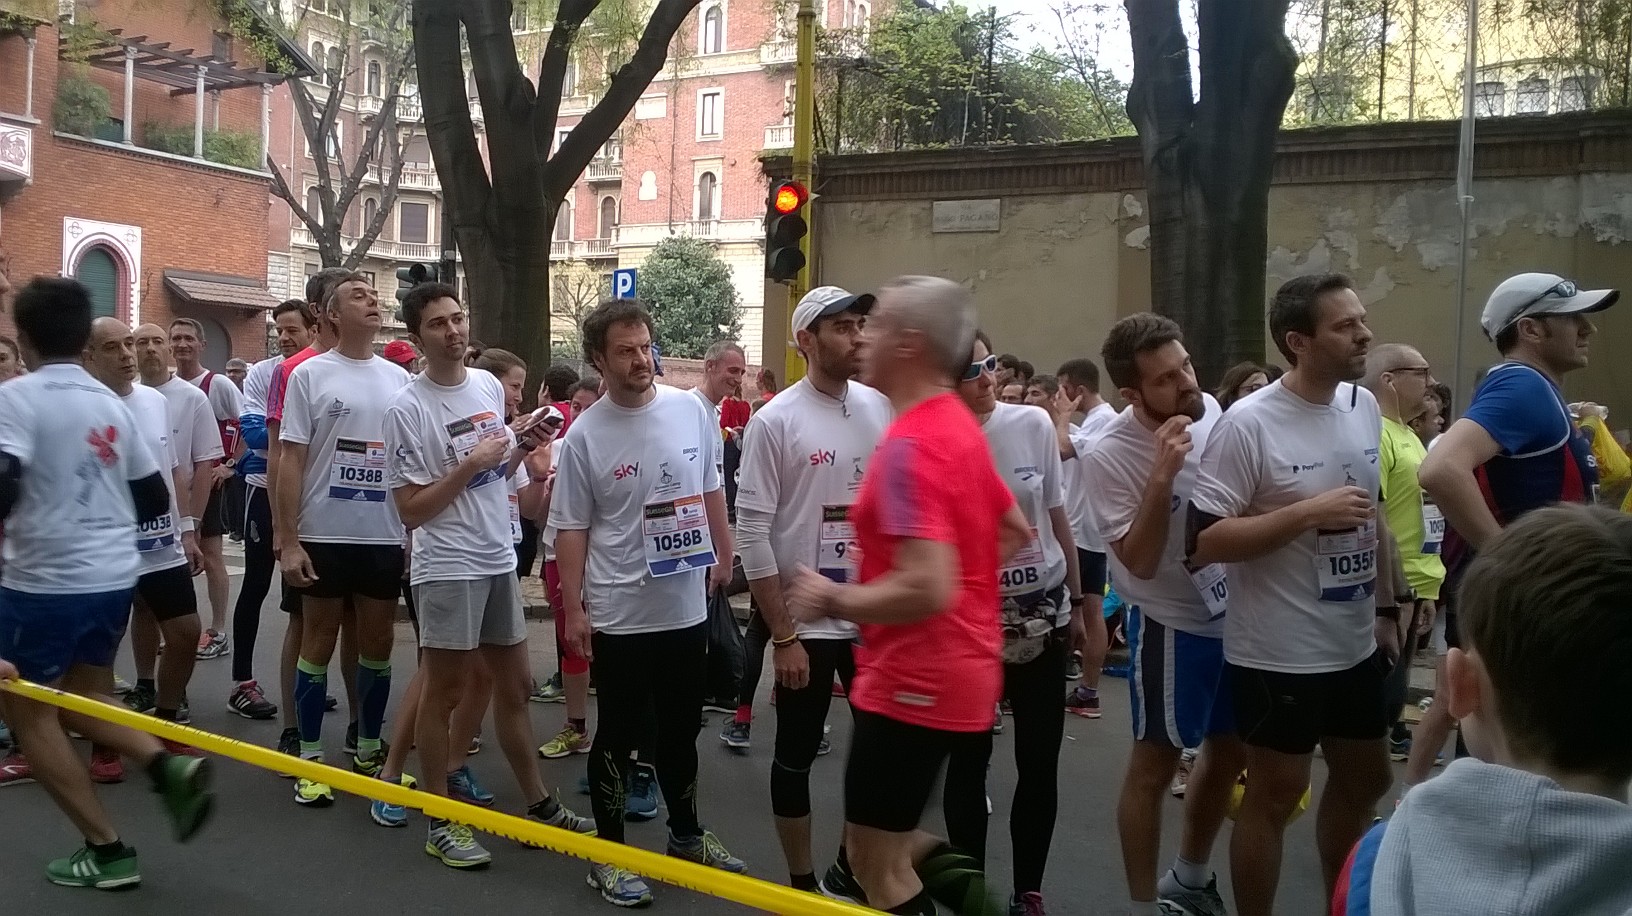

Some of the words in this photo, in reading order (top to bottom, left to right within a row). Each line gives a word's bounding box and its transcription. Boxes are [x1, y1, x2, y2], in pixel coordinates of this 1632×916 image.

[617, 272, 632, 300] P
[810, 449, 836, 466] sky
[1302, 461, 1323, 471] PayPal
[340, 466, 383, 483] 1038B
[613, 461, 640, 481] sky
[137, 515, 171, 533] 003B
[653, 528, 703, 553] 1058B
